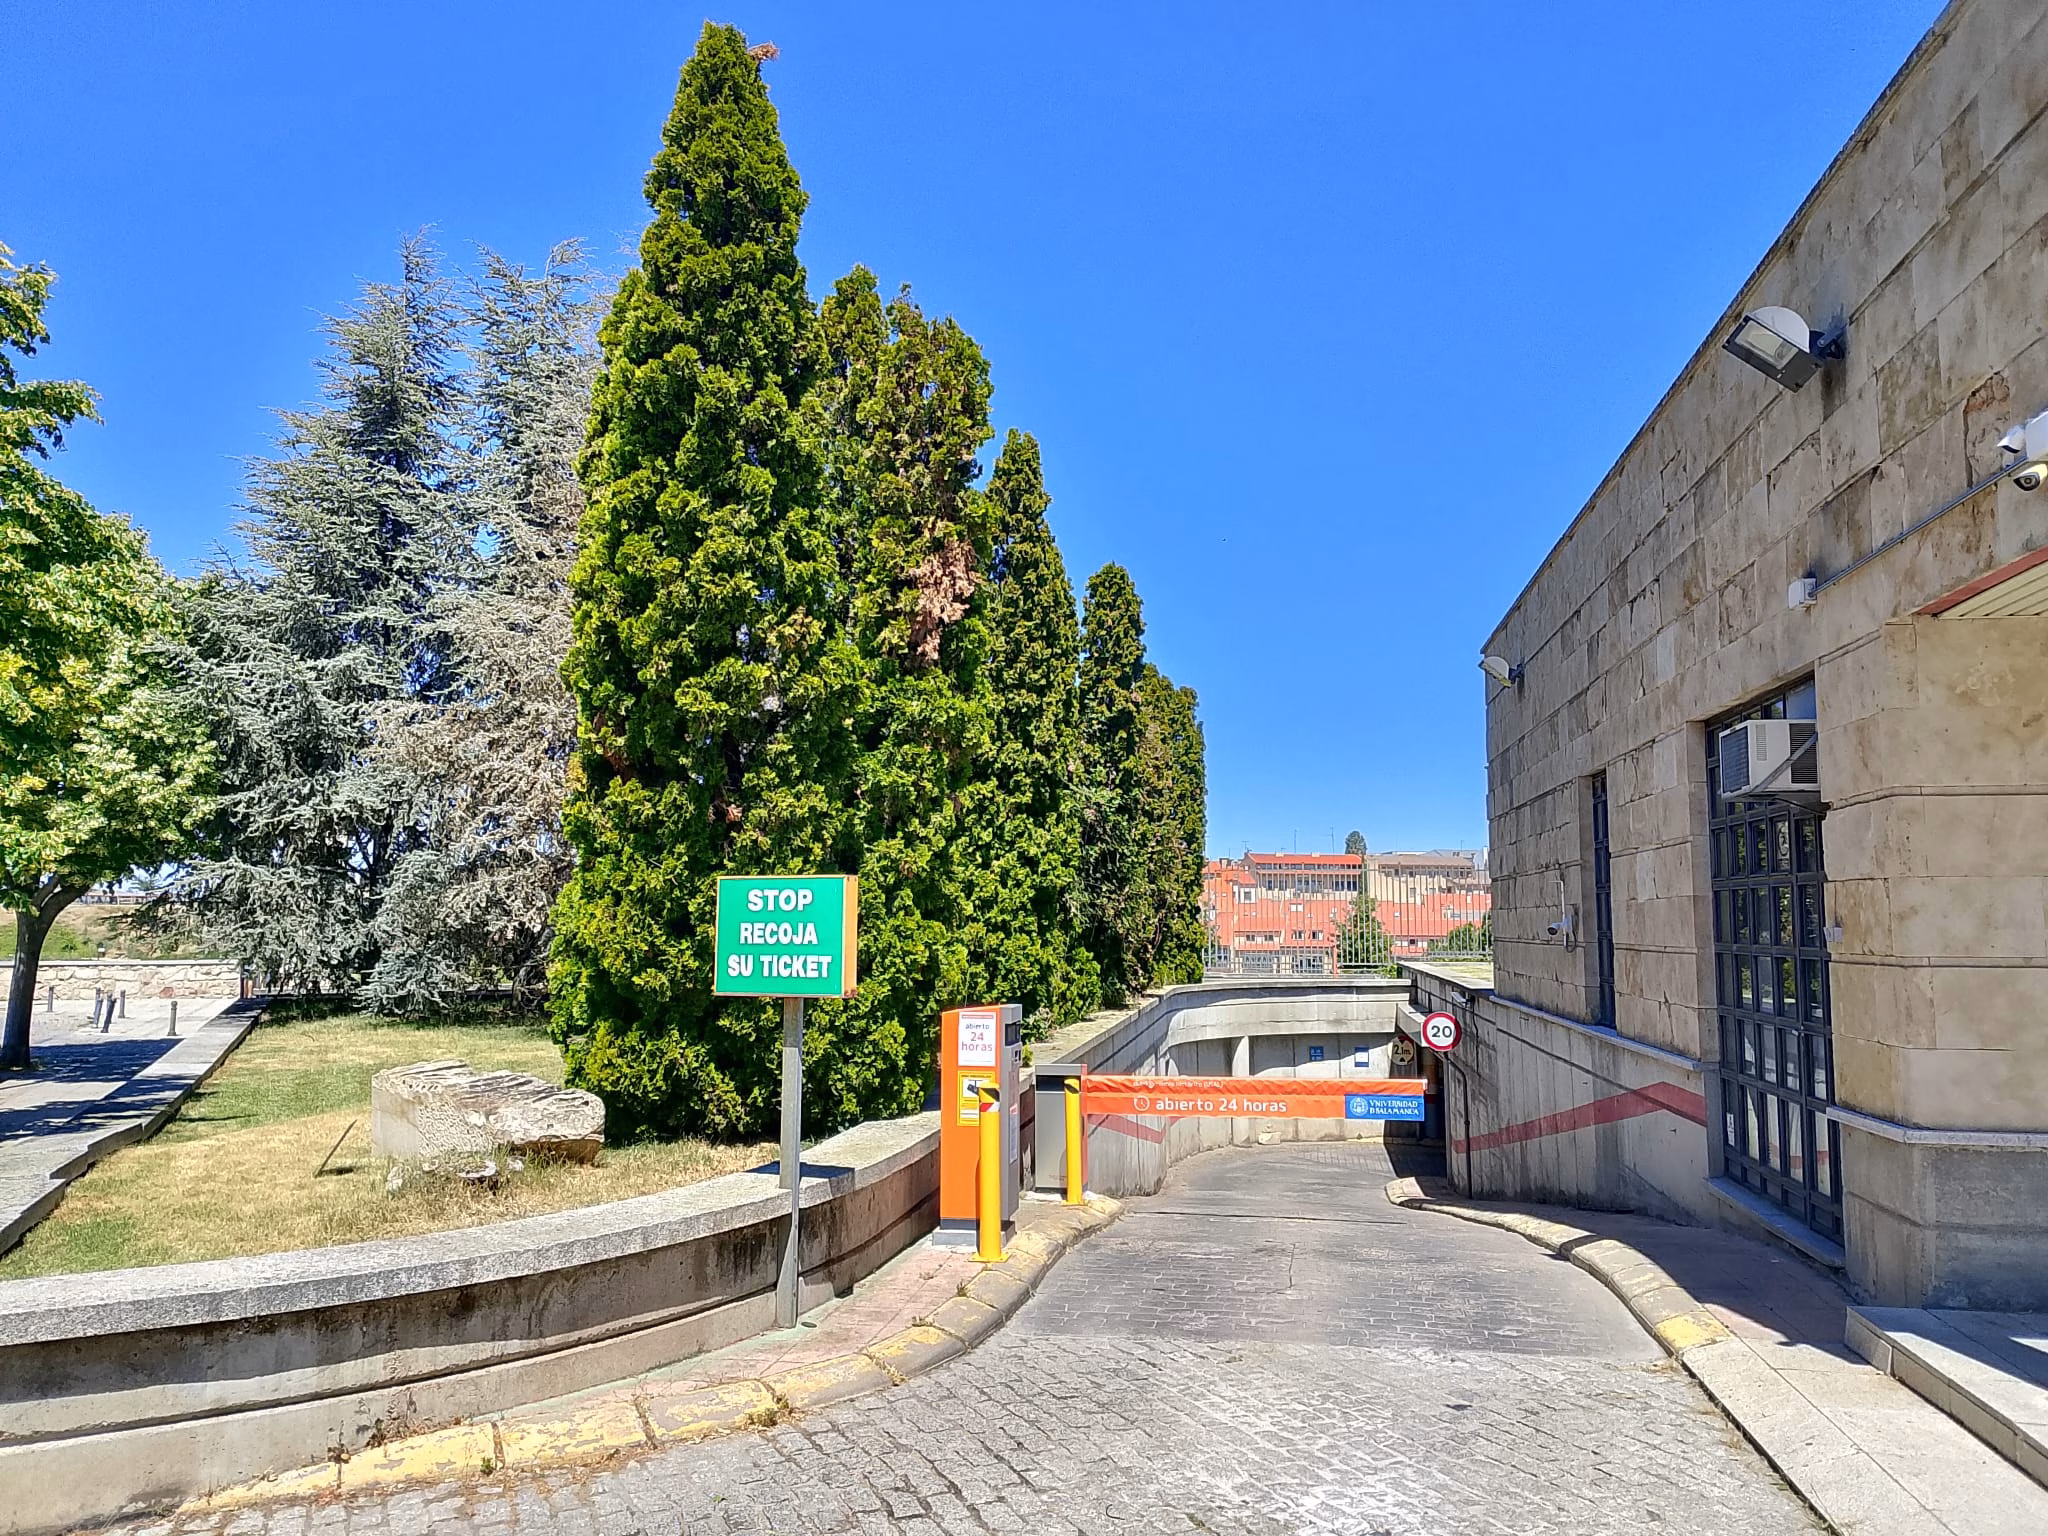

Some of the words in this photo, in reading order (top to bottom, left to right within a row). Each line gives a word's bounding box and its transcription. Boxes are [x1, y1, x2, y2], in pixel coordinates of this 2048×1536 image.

[747, 888, 813, 911] STOP
[740, 922, 818, 944] RECOJA
[727, 954, 754, 977] SU
[759, 954, 833, 978] TICKET
[970, 1031, 985, 1042] 24
[1431, 1025, 1453, 1038] 20
[961, 1041, 993, 1052] horas
[1155, 1097, 1214, 1112] abierto
[1218, 1098, 1238, 1112] 24
[1243, 1099, 1287, 1112] horas
